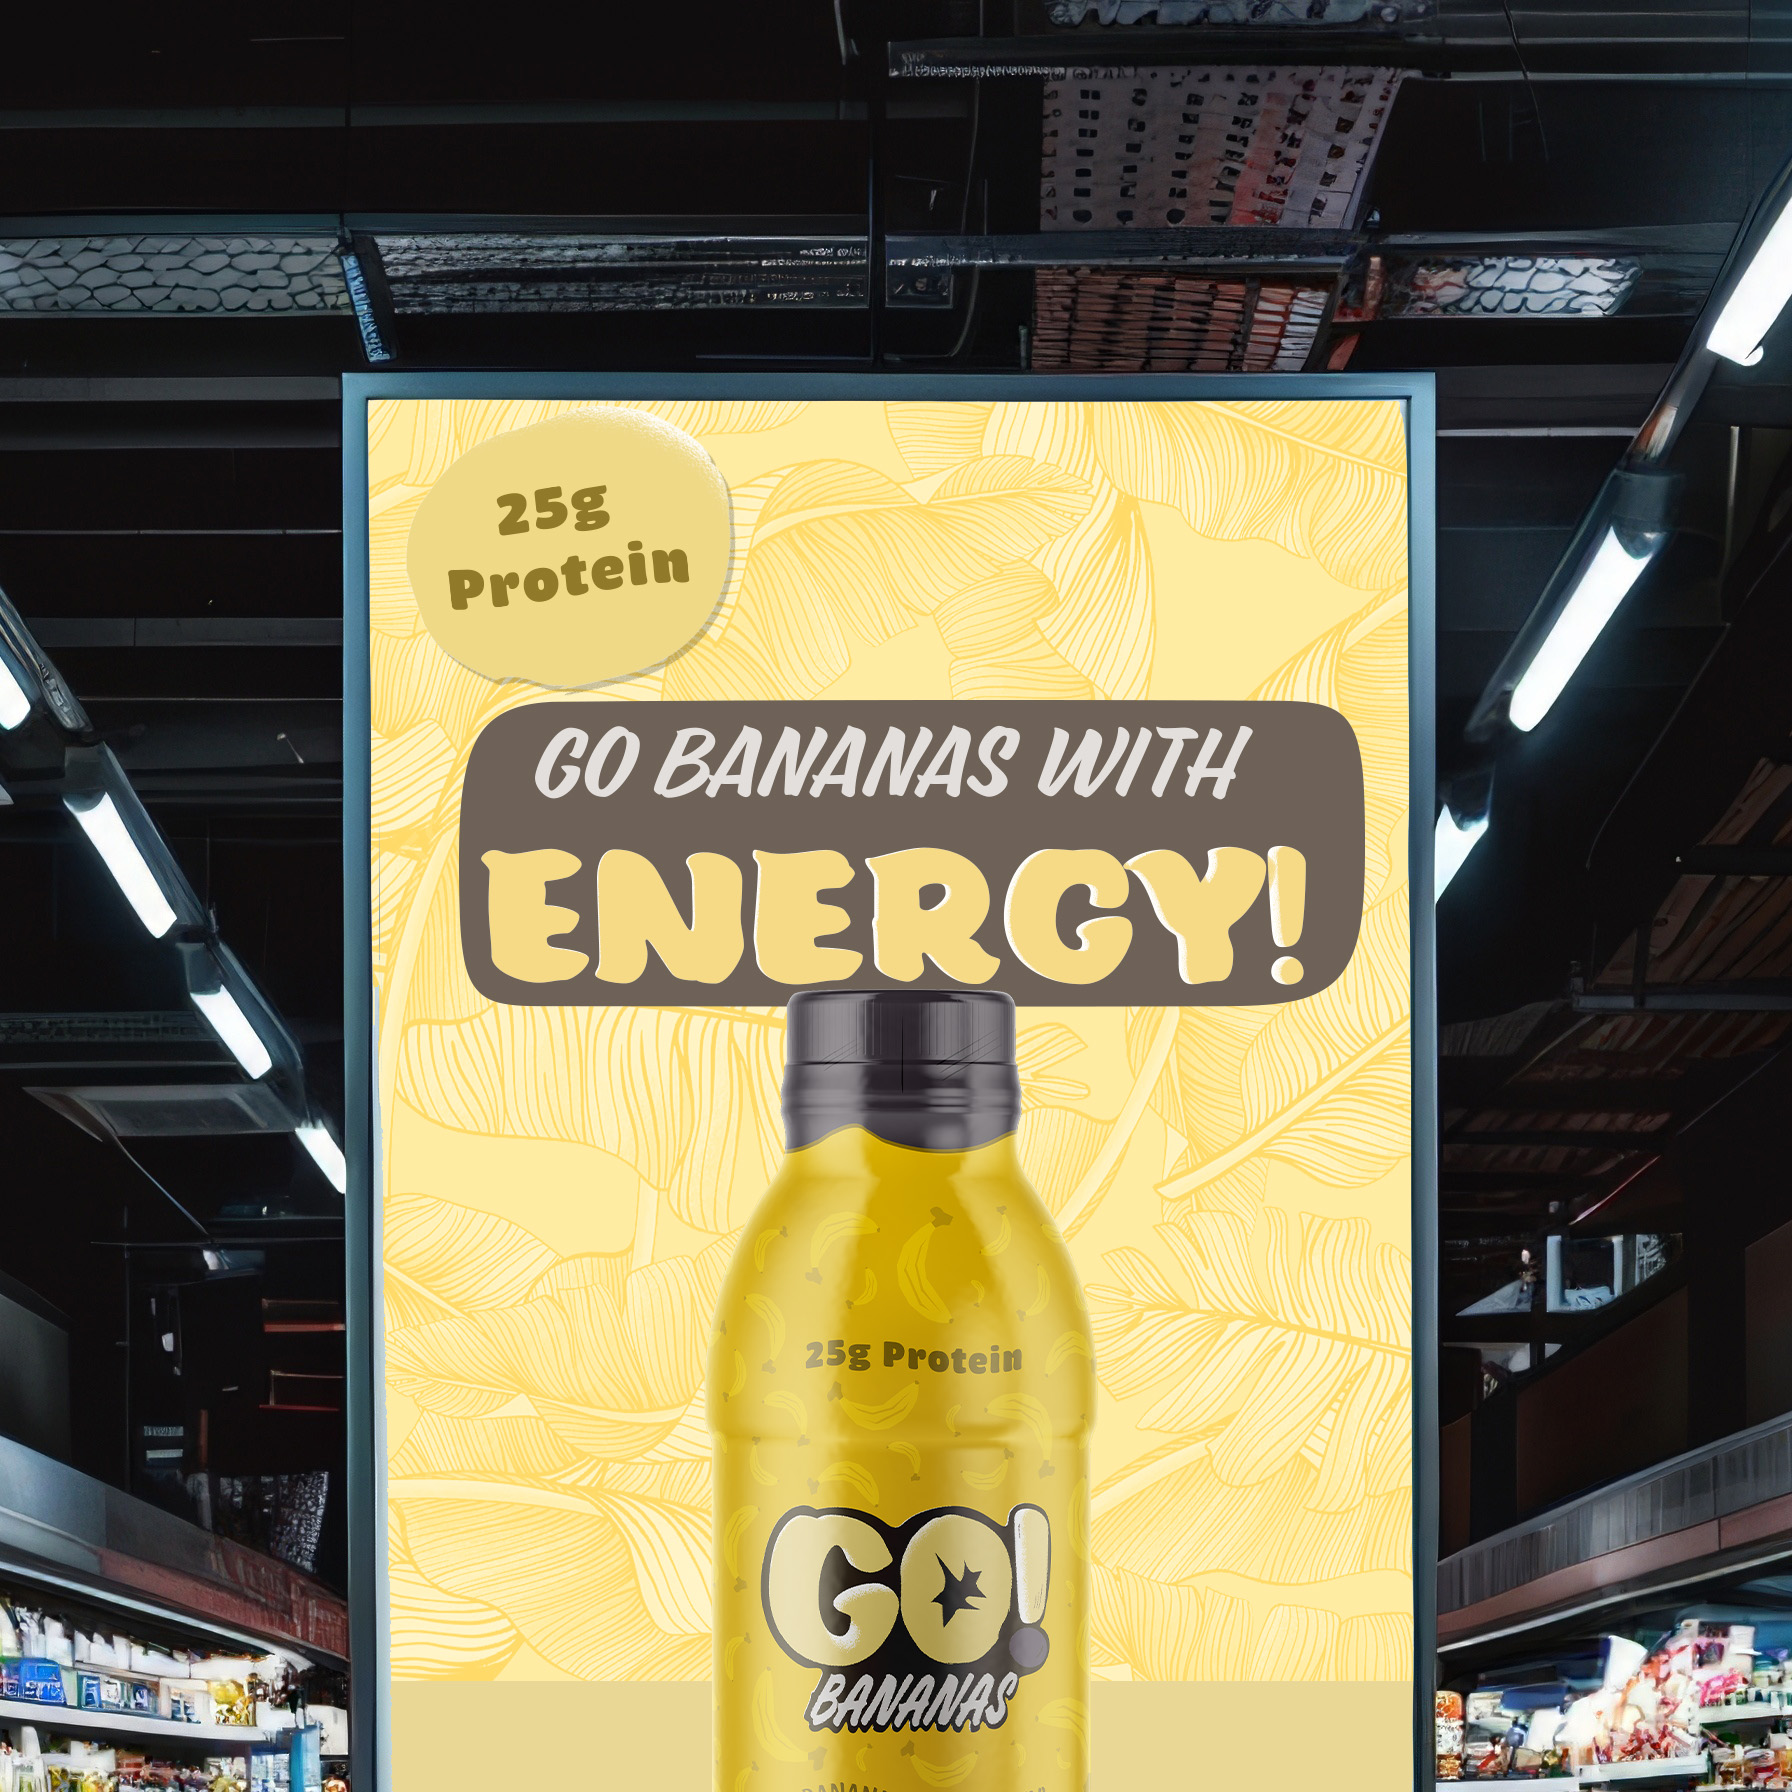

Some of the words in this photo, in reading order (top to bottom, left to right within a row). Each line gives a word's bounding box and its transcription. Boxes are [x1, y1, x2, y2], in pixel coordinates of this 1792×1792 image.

[496, 482, 610, 536] 25g
[446, 541, 691, 611] Protein
[533, 726, 643, 800] GO
[652, 723, 1020, 799] BANANAS
[1036, 725, 1254, 801] WITH
[480, 845, 1307, 987] ENERGY!
[805, 1339, 871, 1372] 25g
[882, 1340, 1023, 1376] Protein
[762, 1504, 1052, 1670] GO!
[808, 1670, 1020, 1732] BANANAS
